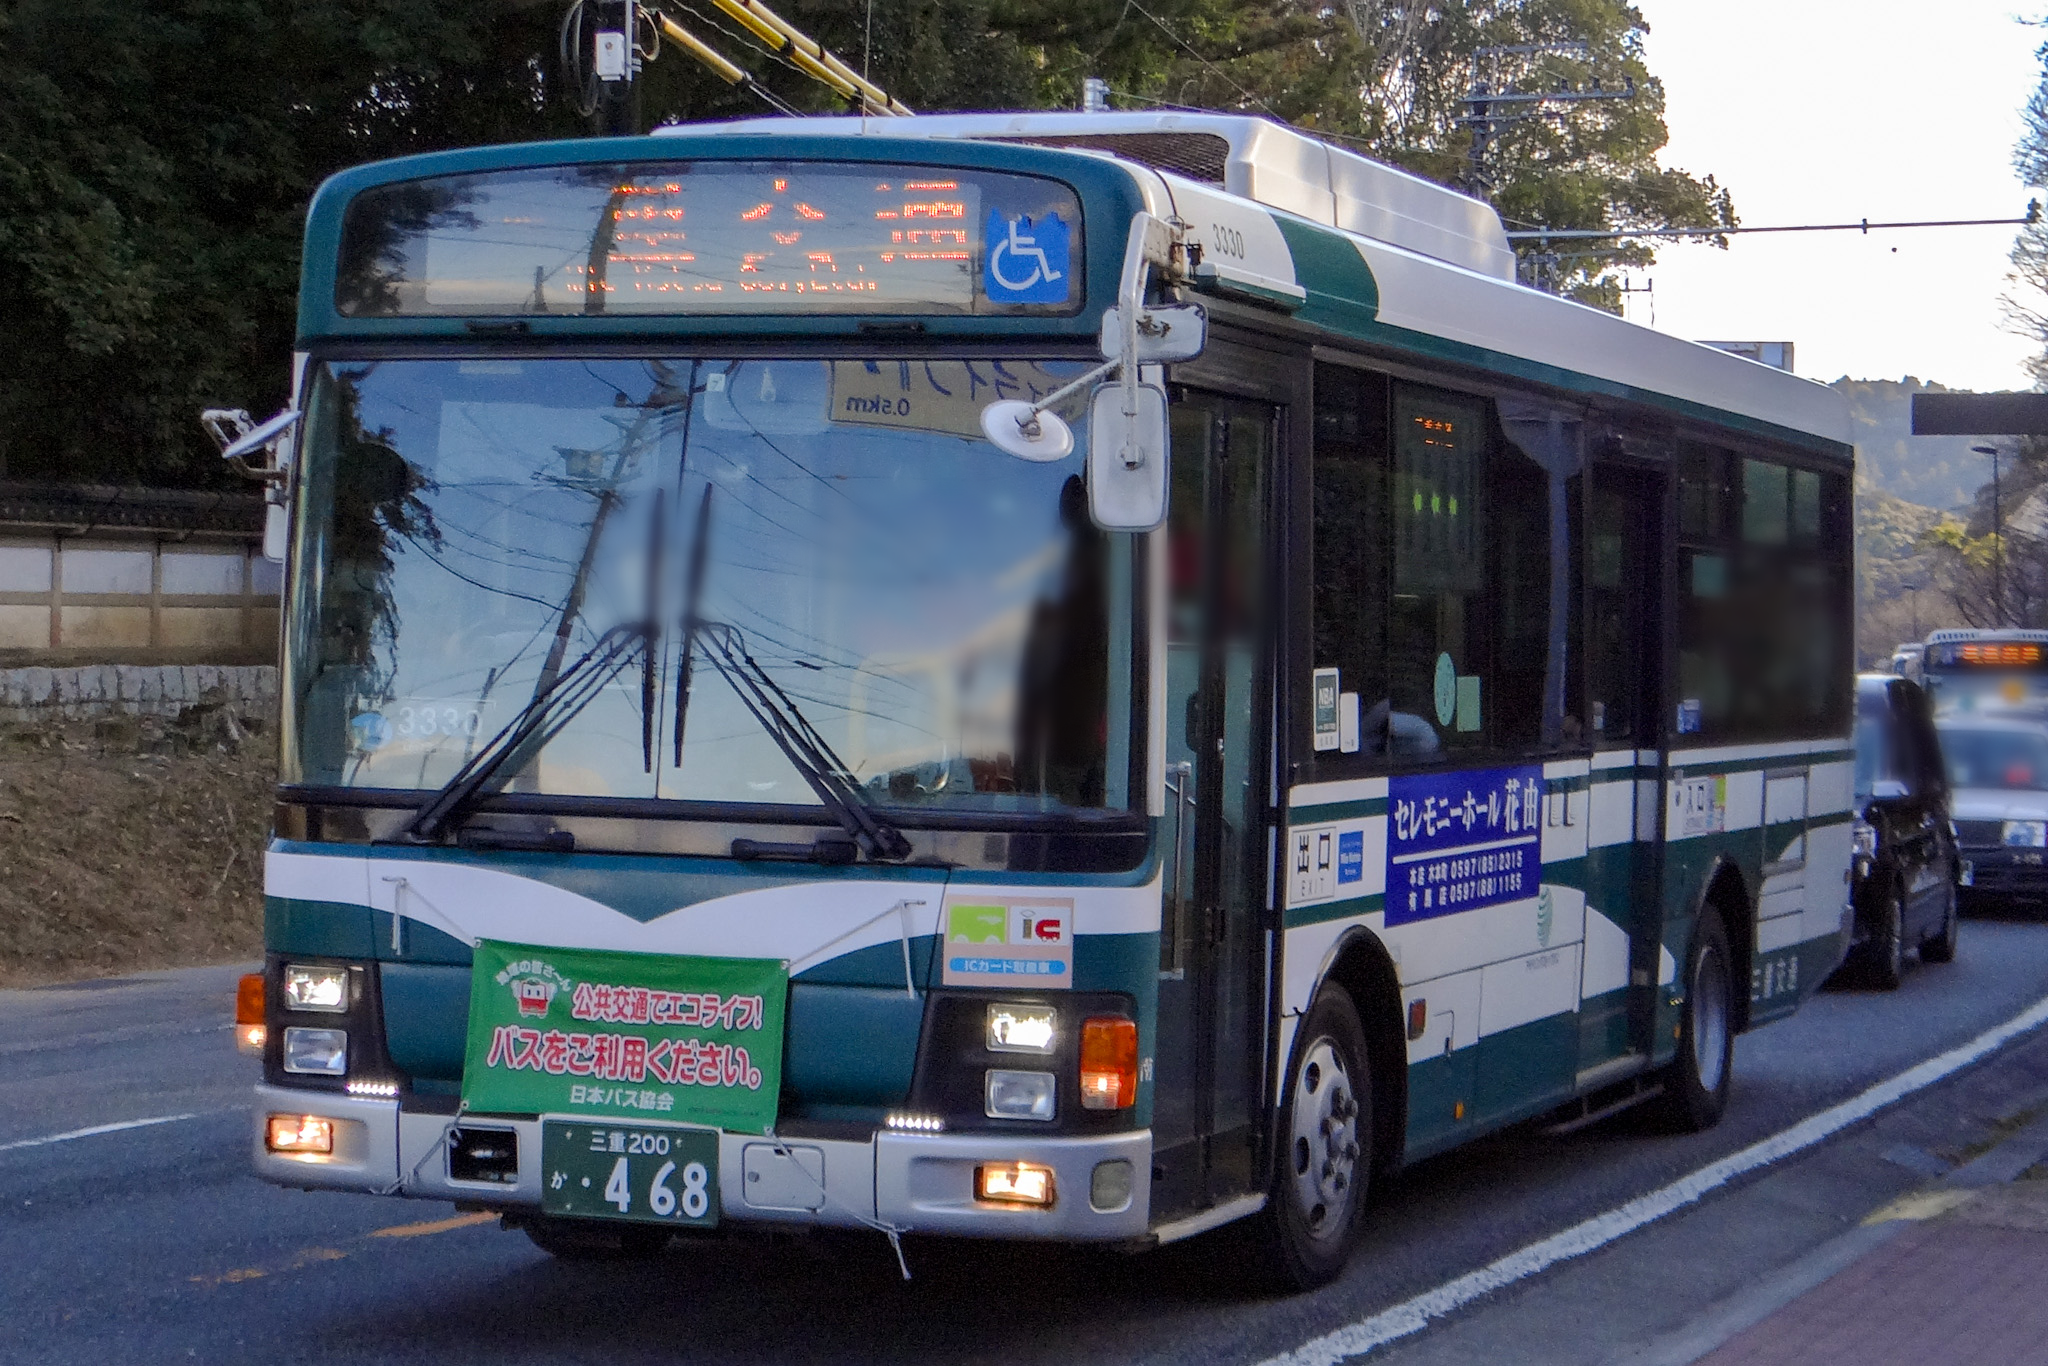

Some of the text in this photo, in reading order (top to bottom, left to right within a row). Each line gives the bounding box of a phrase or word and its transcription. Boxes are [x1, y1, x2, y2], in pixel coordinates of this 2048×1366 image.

[1212, 222, 1245, 260] 3330
[398, 706, 483, 737] 3330
[1297, 832, 1331, 875] 出口
[1300, 876, 1326, 898] EXIT
[486, 1024, 763, 1091] バスをご利用ください。
[569, 1084, 675, 1112] 日本バス協会
